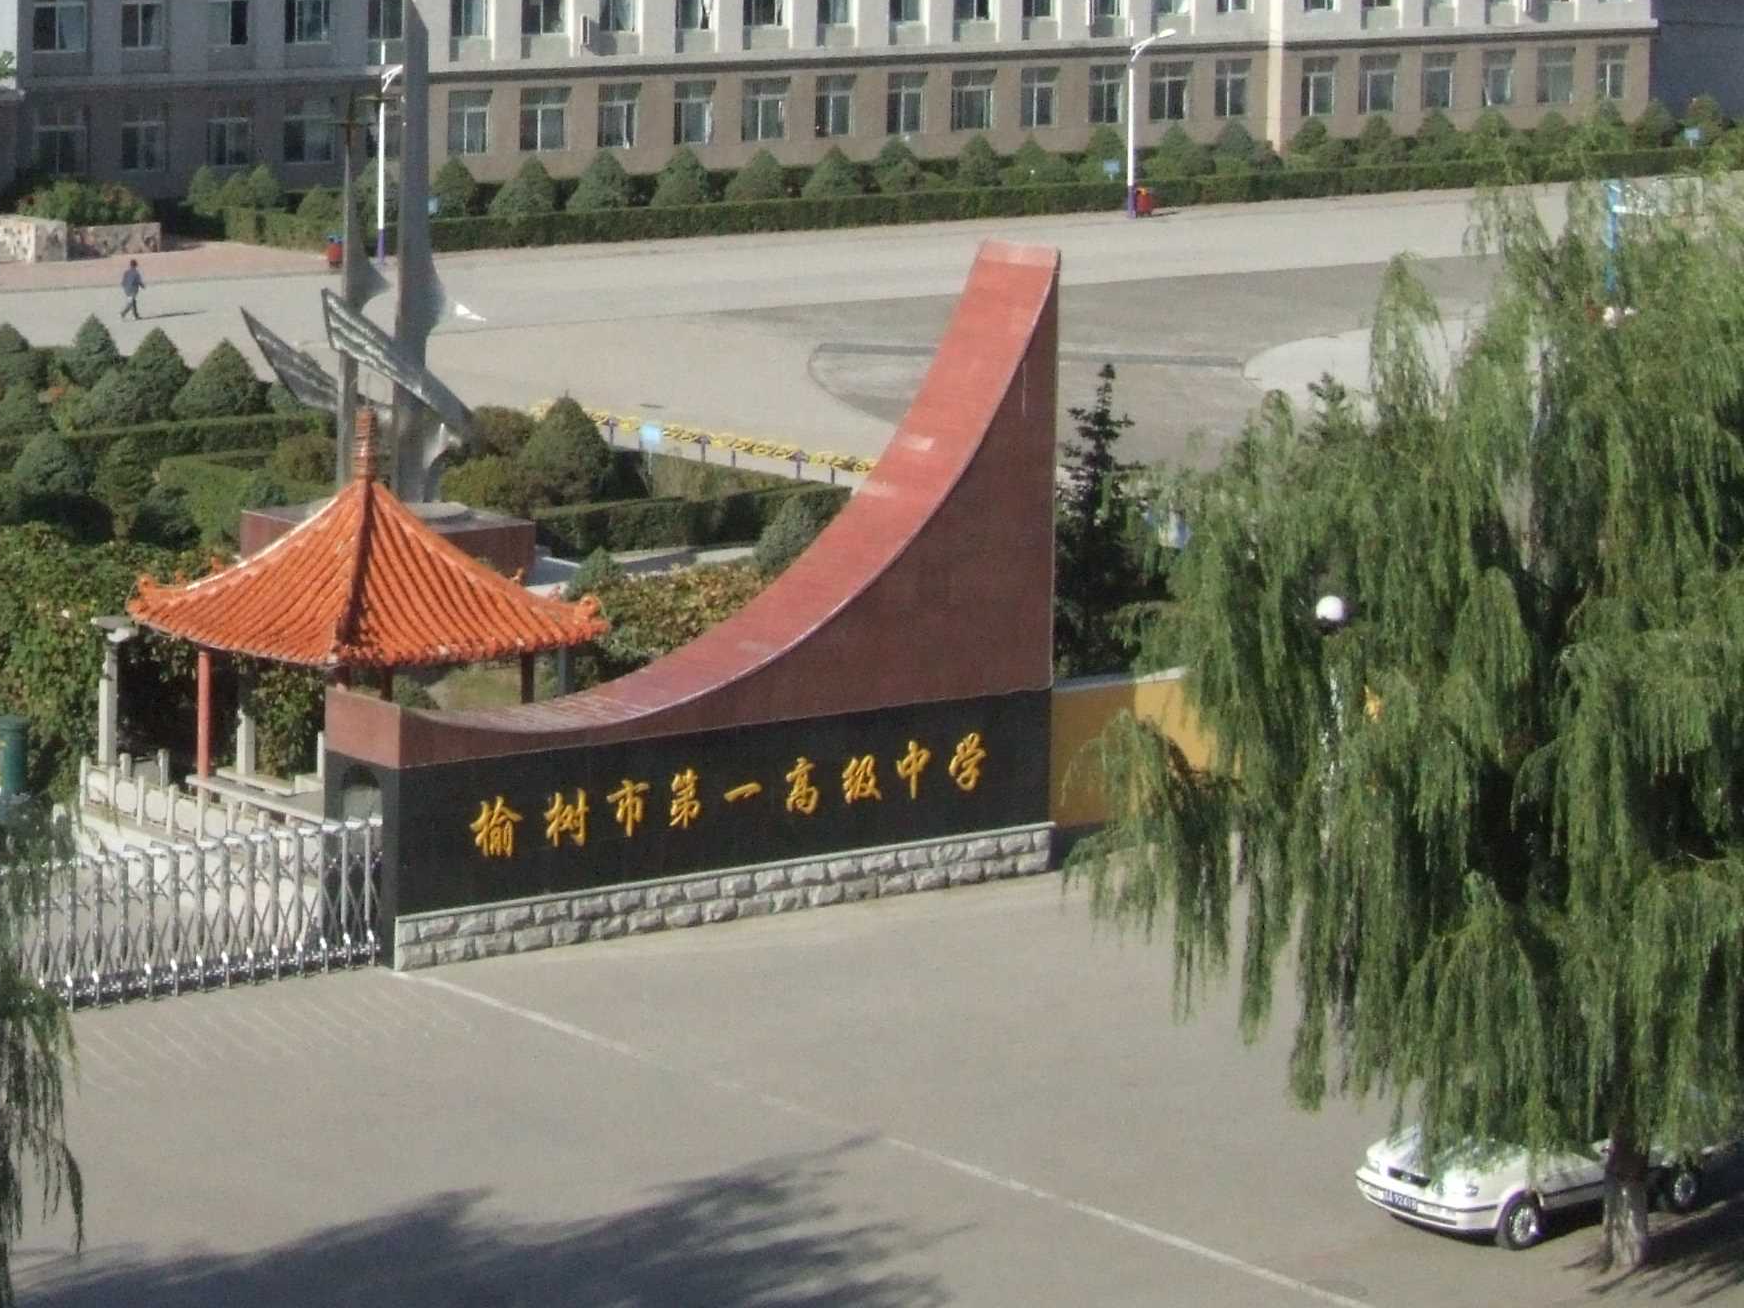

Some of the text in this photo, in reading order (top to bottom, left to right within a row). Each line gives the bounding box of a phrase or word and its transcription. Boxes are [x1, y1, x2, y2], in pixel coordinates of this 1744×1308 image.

[469, 732, 988, 859] 榆树市第一高级中学
